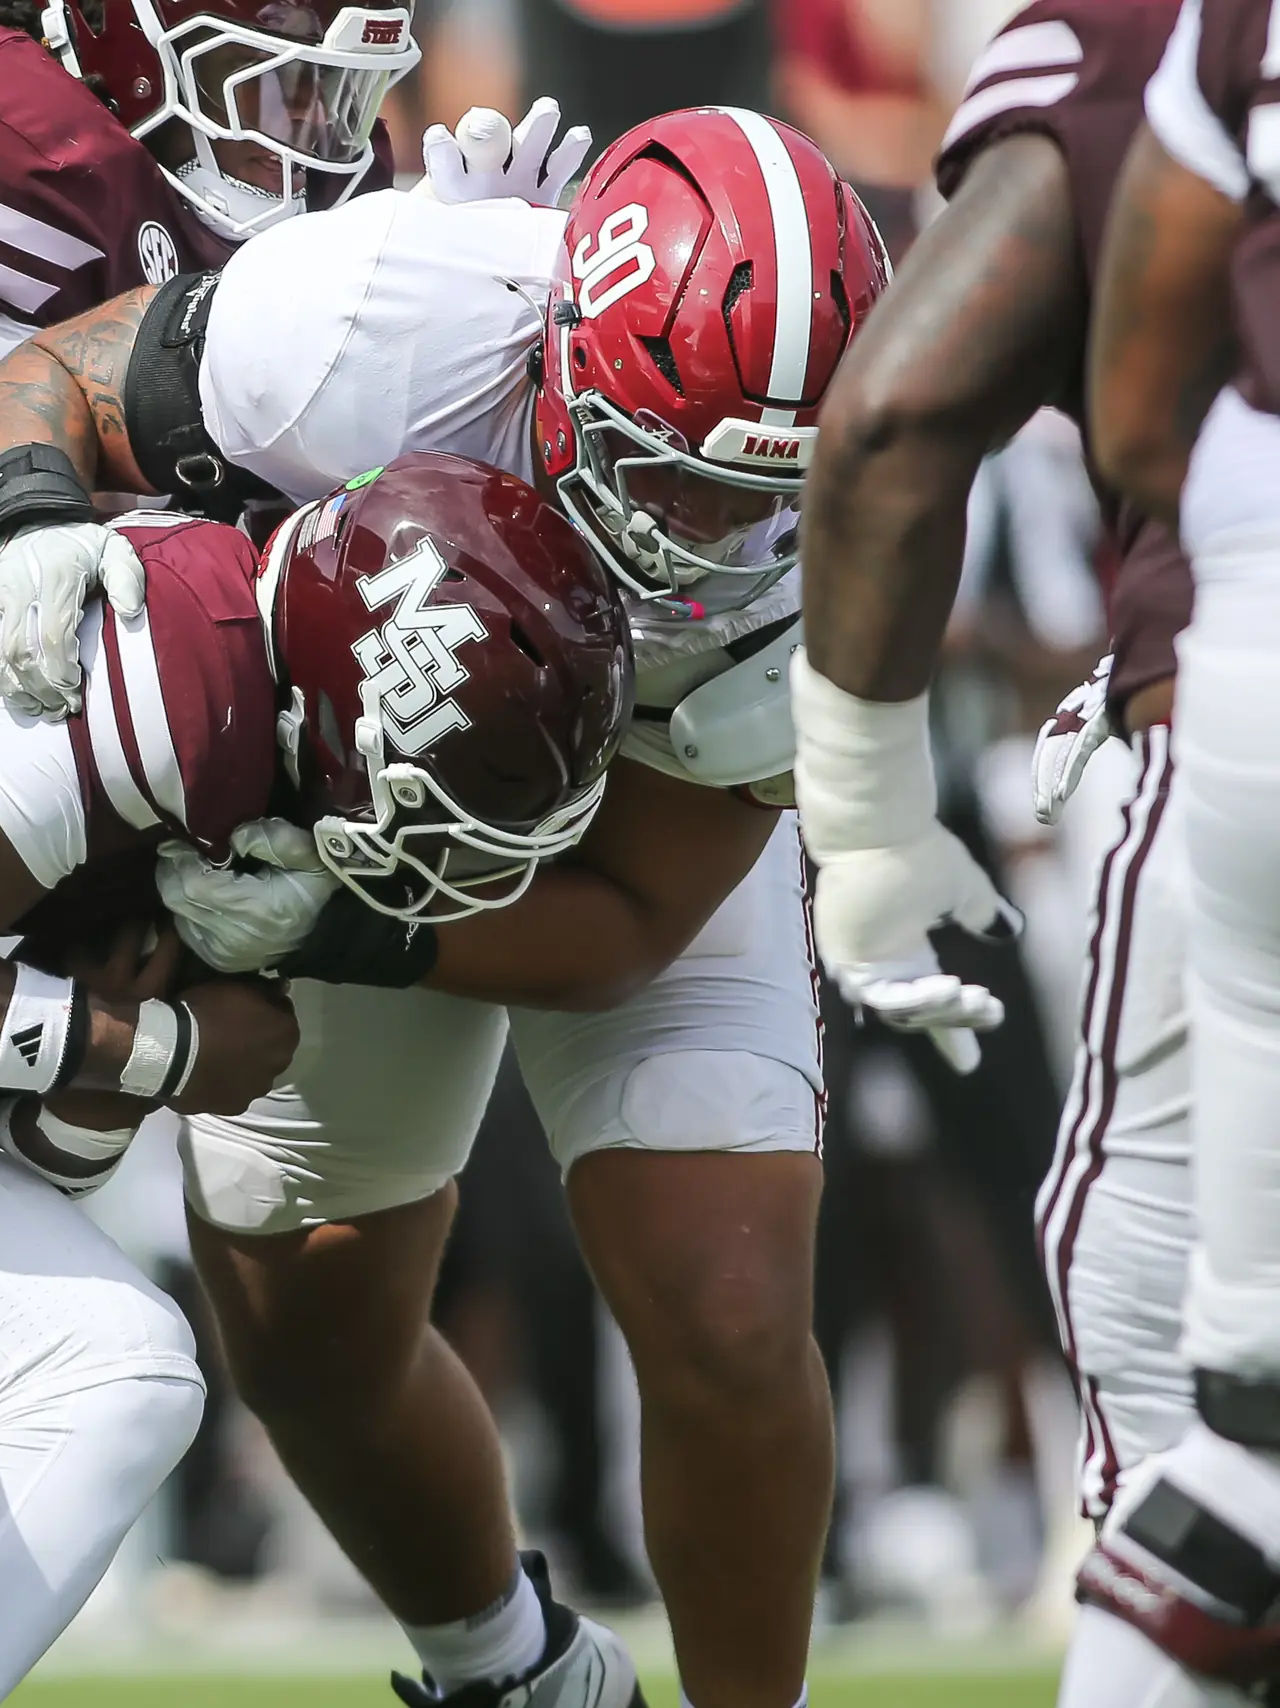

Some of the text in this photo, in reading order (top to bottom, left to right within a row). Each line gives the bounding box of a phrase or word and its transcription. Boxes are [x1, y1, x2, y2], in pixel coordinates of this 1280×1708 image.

[141, 227, 175, 284] SEC
[571, 202, 657, 320] 90
[742, 435, 800, 458] BAMA
